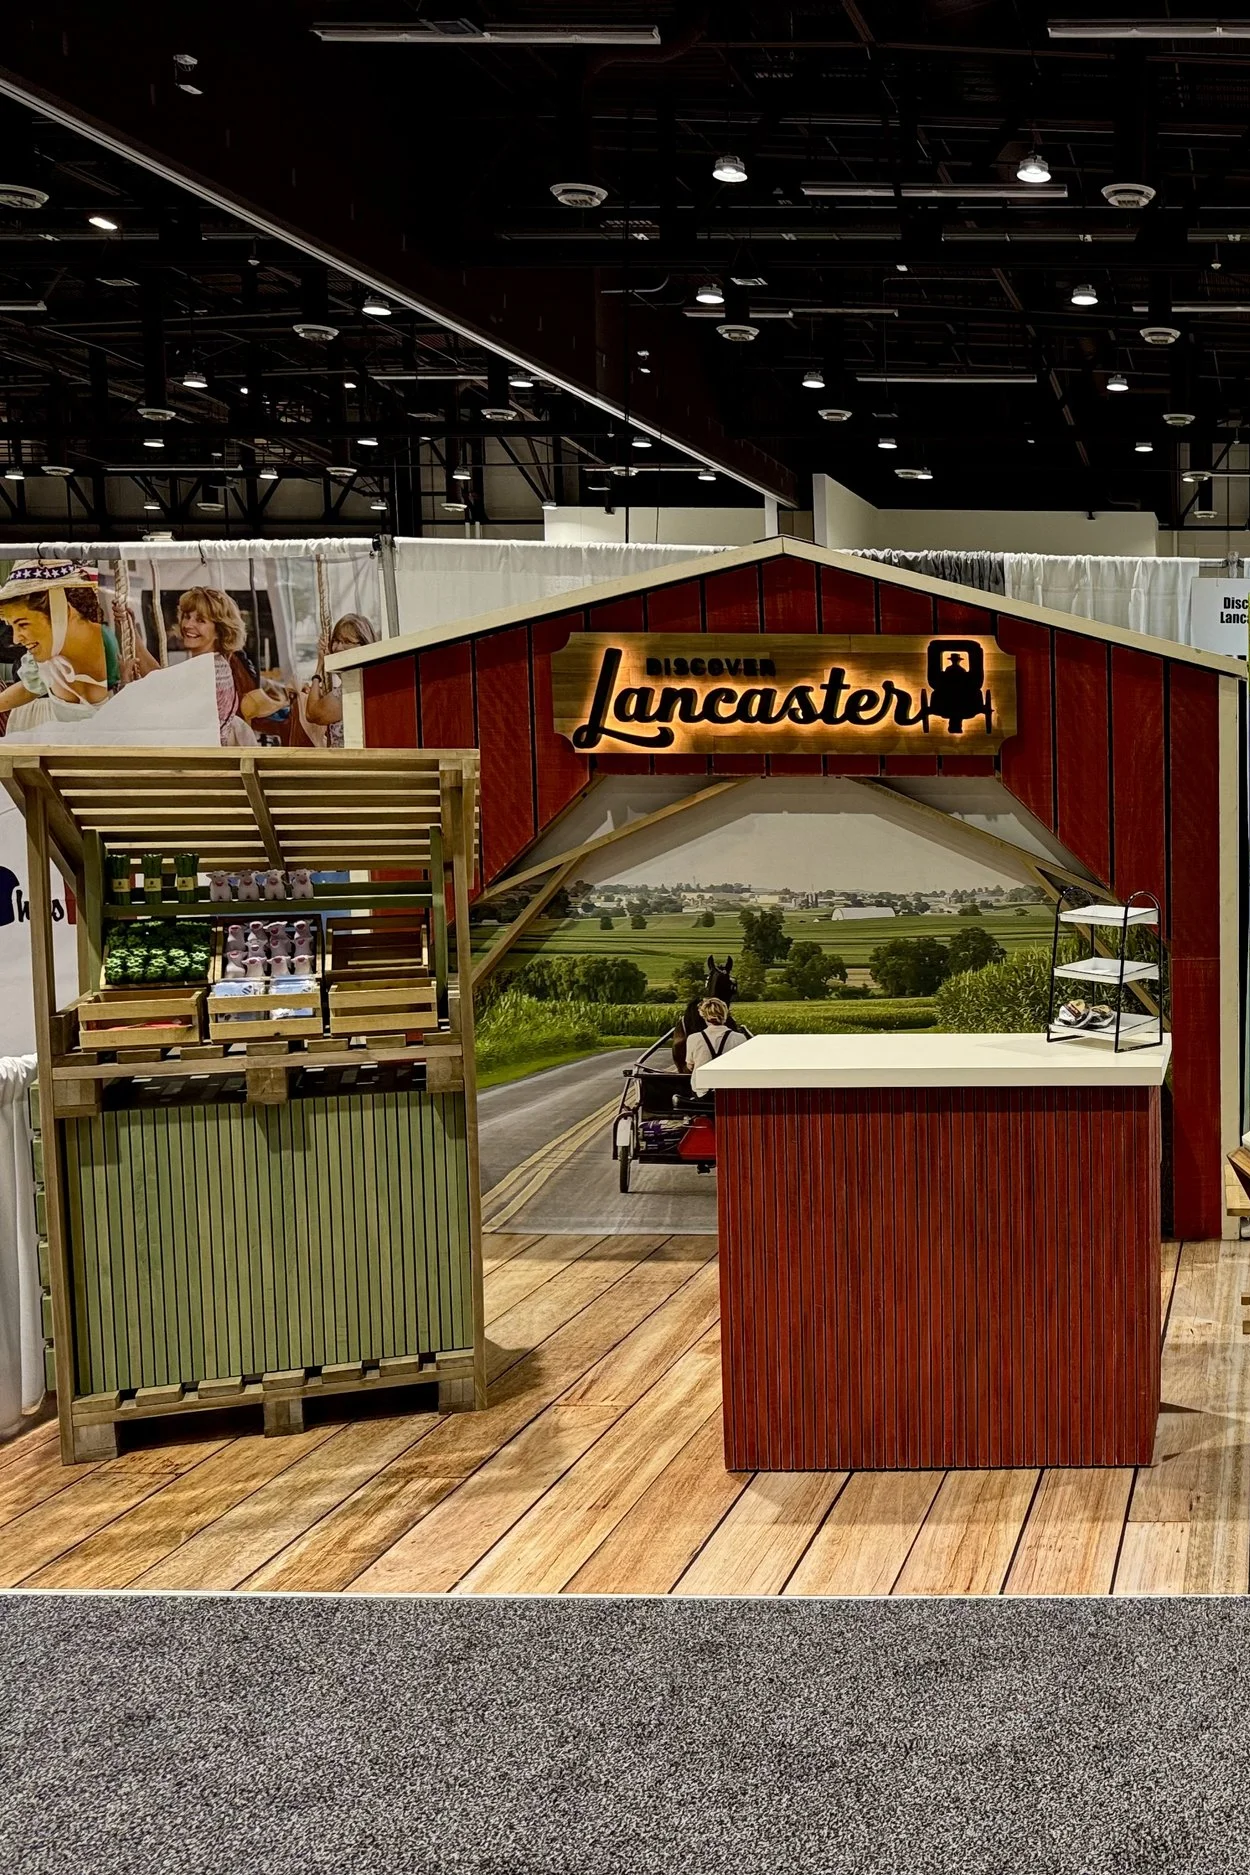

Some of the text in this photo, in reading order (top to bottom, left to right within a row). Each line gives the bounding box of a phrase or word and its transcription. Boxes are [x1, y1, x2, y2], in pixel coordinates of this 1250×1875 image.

[1223, 597, 1249, 610] Disc
[646, 657, 776, 677] DISCOVER
[573, 647, 924, 750] Lancaster
